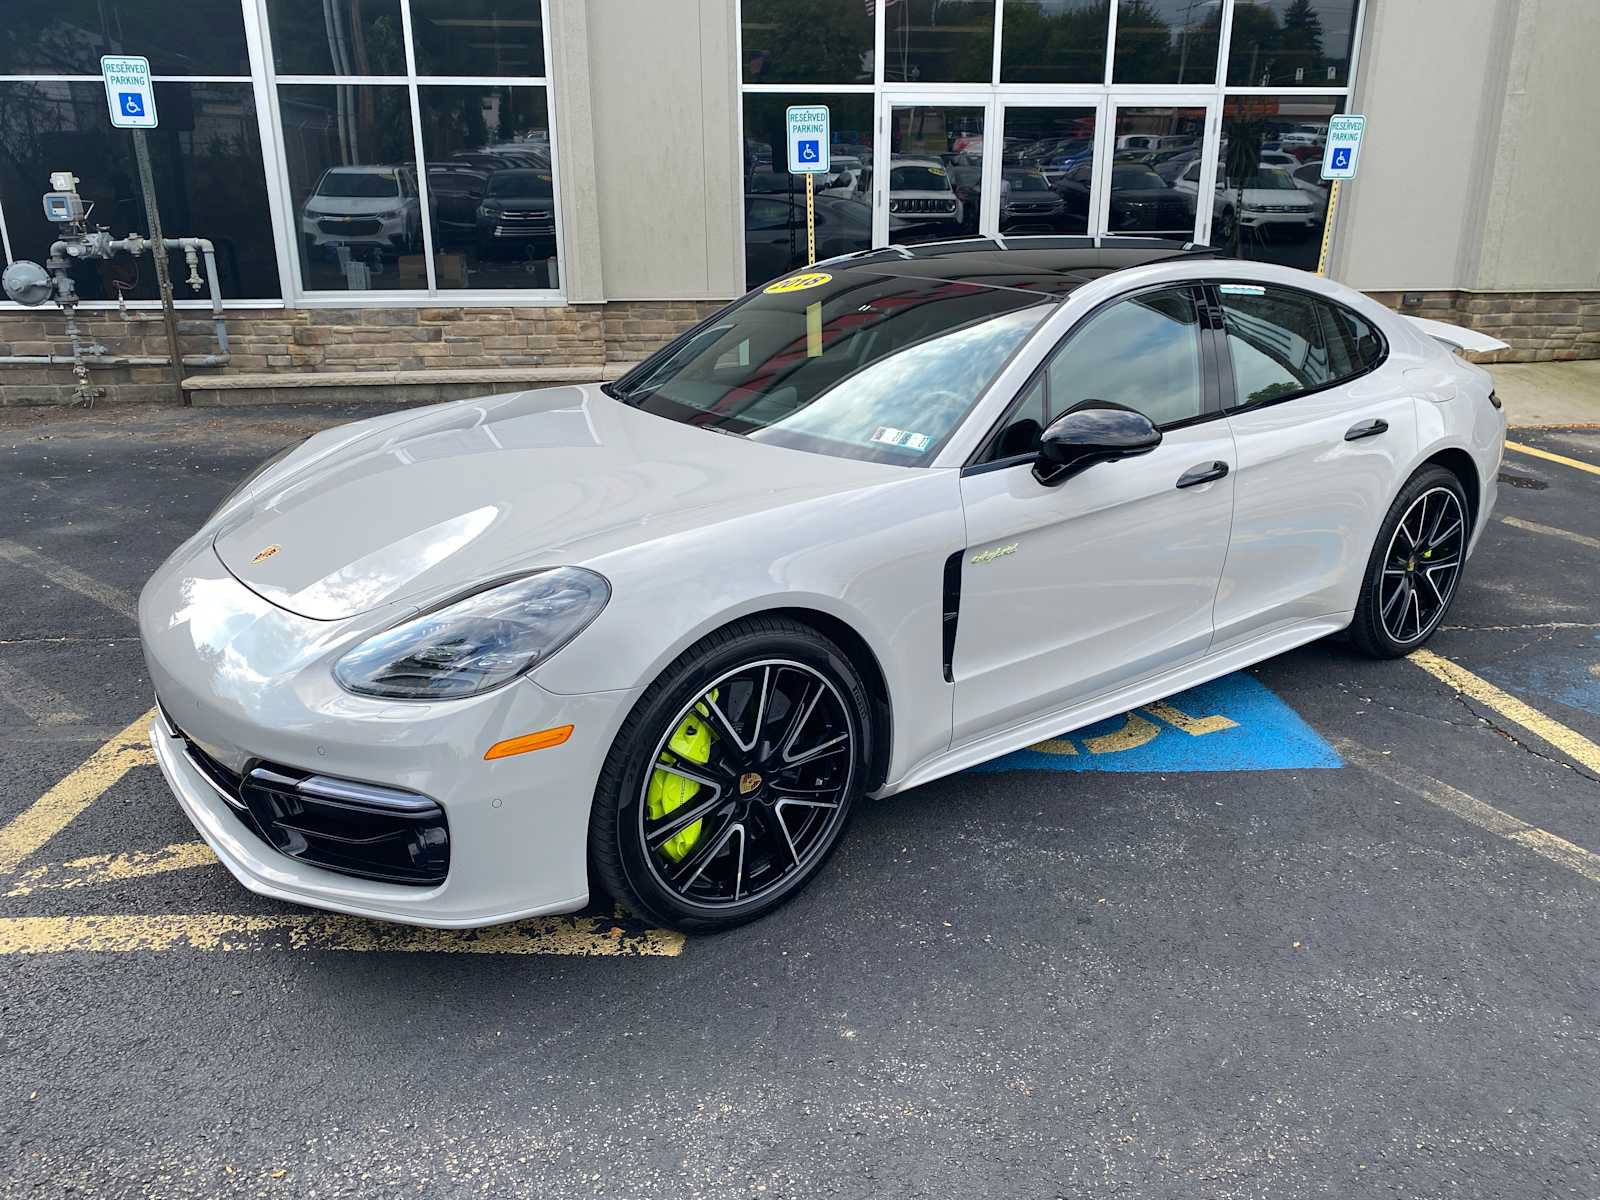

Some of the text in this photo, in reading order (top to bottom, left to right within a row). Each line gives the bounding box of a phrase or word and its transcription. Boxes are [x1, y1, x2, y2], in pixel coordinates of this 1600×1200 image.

[105, 63, 146, 74] RESERVED
[110, 75, 145, 86] PARKING
[790, 113, 826, 122] RESERVED
[792, 124, 823, 133] PARKING
[1331, 121, 1362, 131] RESERVED
[1332, 132, 1359, 141] PARKING
